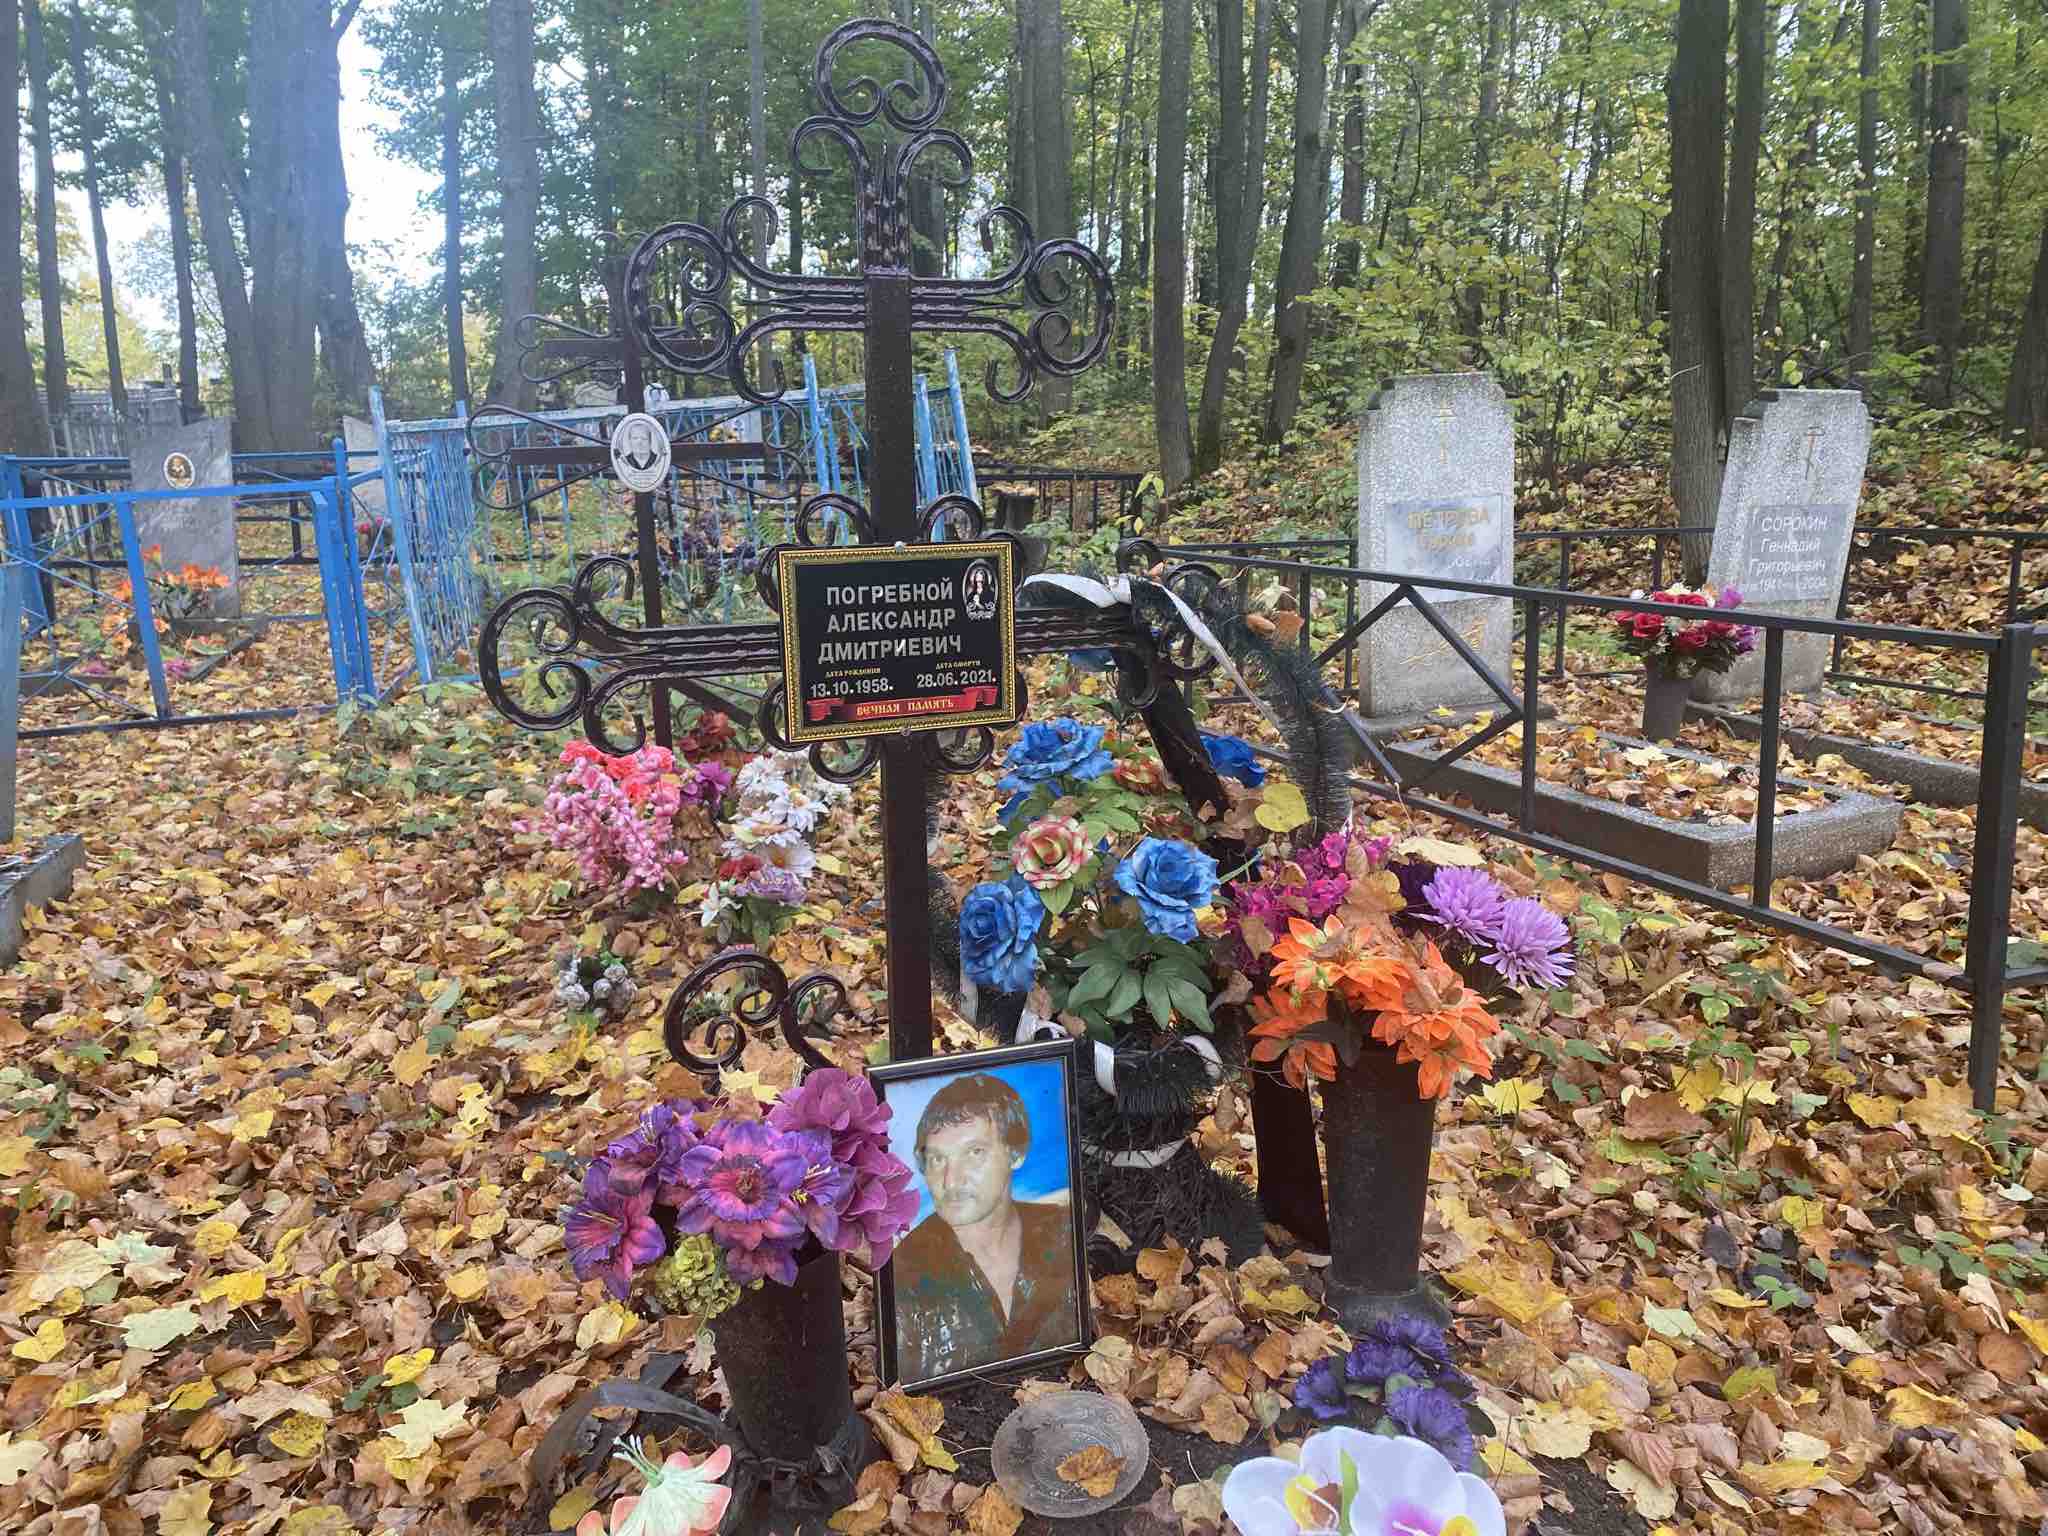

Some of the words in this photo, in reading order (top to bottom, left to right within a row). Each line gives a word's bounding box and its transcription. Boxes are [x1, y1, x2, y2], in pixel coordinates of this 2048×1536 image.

[1762, 515, 1828, 532] СОРОКИН
[1760, 537, 1822, 554] Геннадий
[1748, 558, 1826, 577] Григорьевич
[826, 577, 953, 605] ПОГРЕБНОЙ
[827, 608, 957, 633] АЛЕКСАНДР
[817, 635, 962, 664] ДМИТРИЕВИЧ
[810, 677, 894, 698] 13.10.1958.
[916, 669, 997, 688] 28.06.2021.
[856, 705, 900, 717] ВЕЧНАЯ
[907, 699, 954, 711] ПАМЯТЬ
